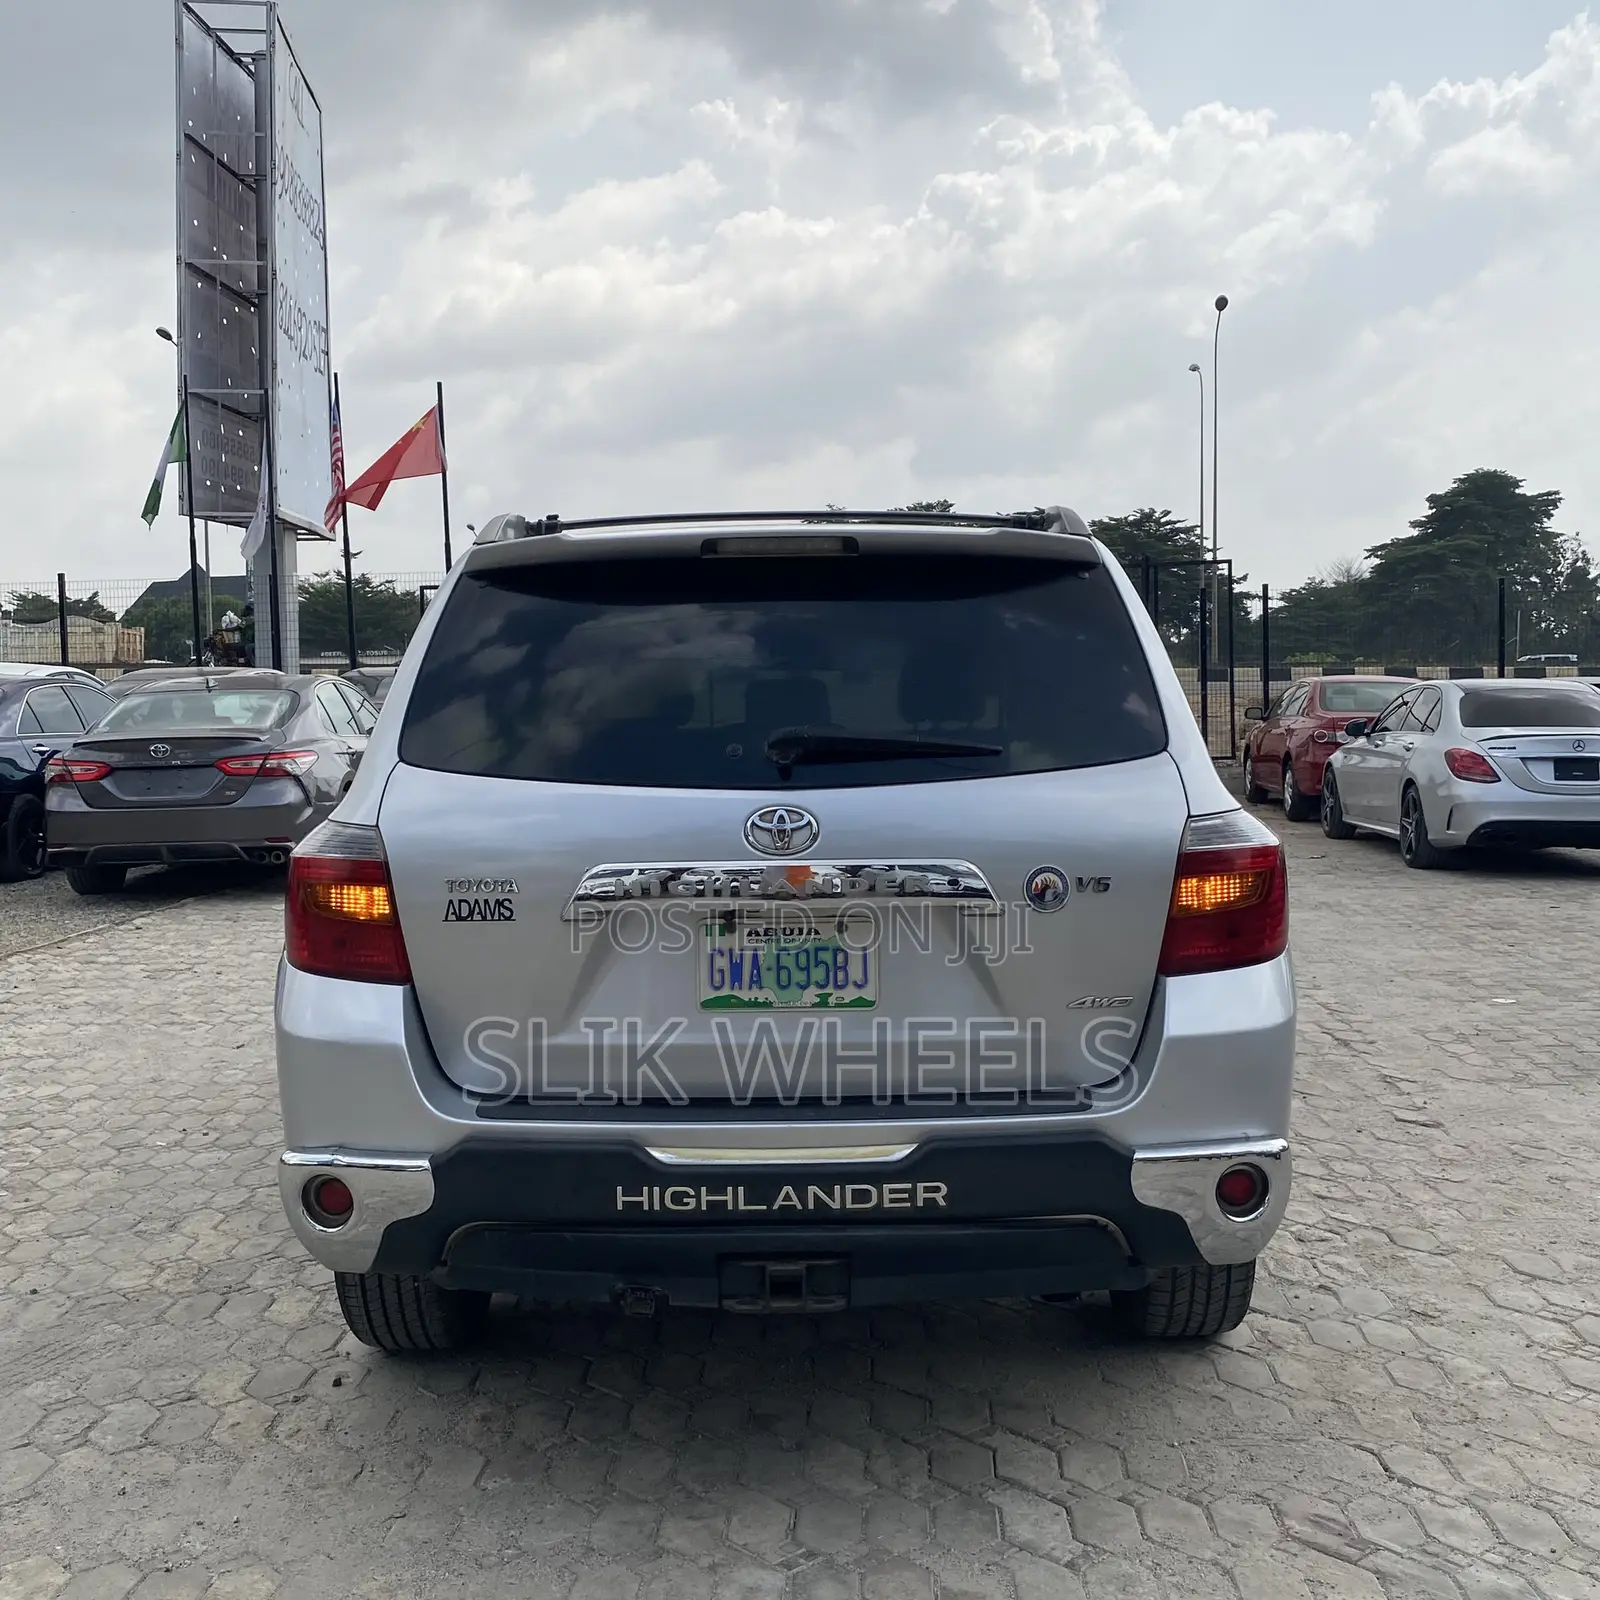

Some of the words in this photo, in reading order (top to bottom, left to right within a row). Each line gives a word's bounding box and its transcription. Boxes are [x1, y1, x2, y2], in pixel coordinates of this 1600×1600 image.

[444, 878, 519, 893] TOYOTA
[614, 876, 931, 898] HIGHLANDER
[1075, 875, 1112, 893] V6
[442, 898, 516, 922] ADAMS
[746, 927, 821, 937] ABUJA
[709, 947, 869, 991] GWA-695BJ
[1066, 995, 1134, 1009] 4WD
[616, 1181, 948, 1210] HIGHLANDER
